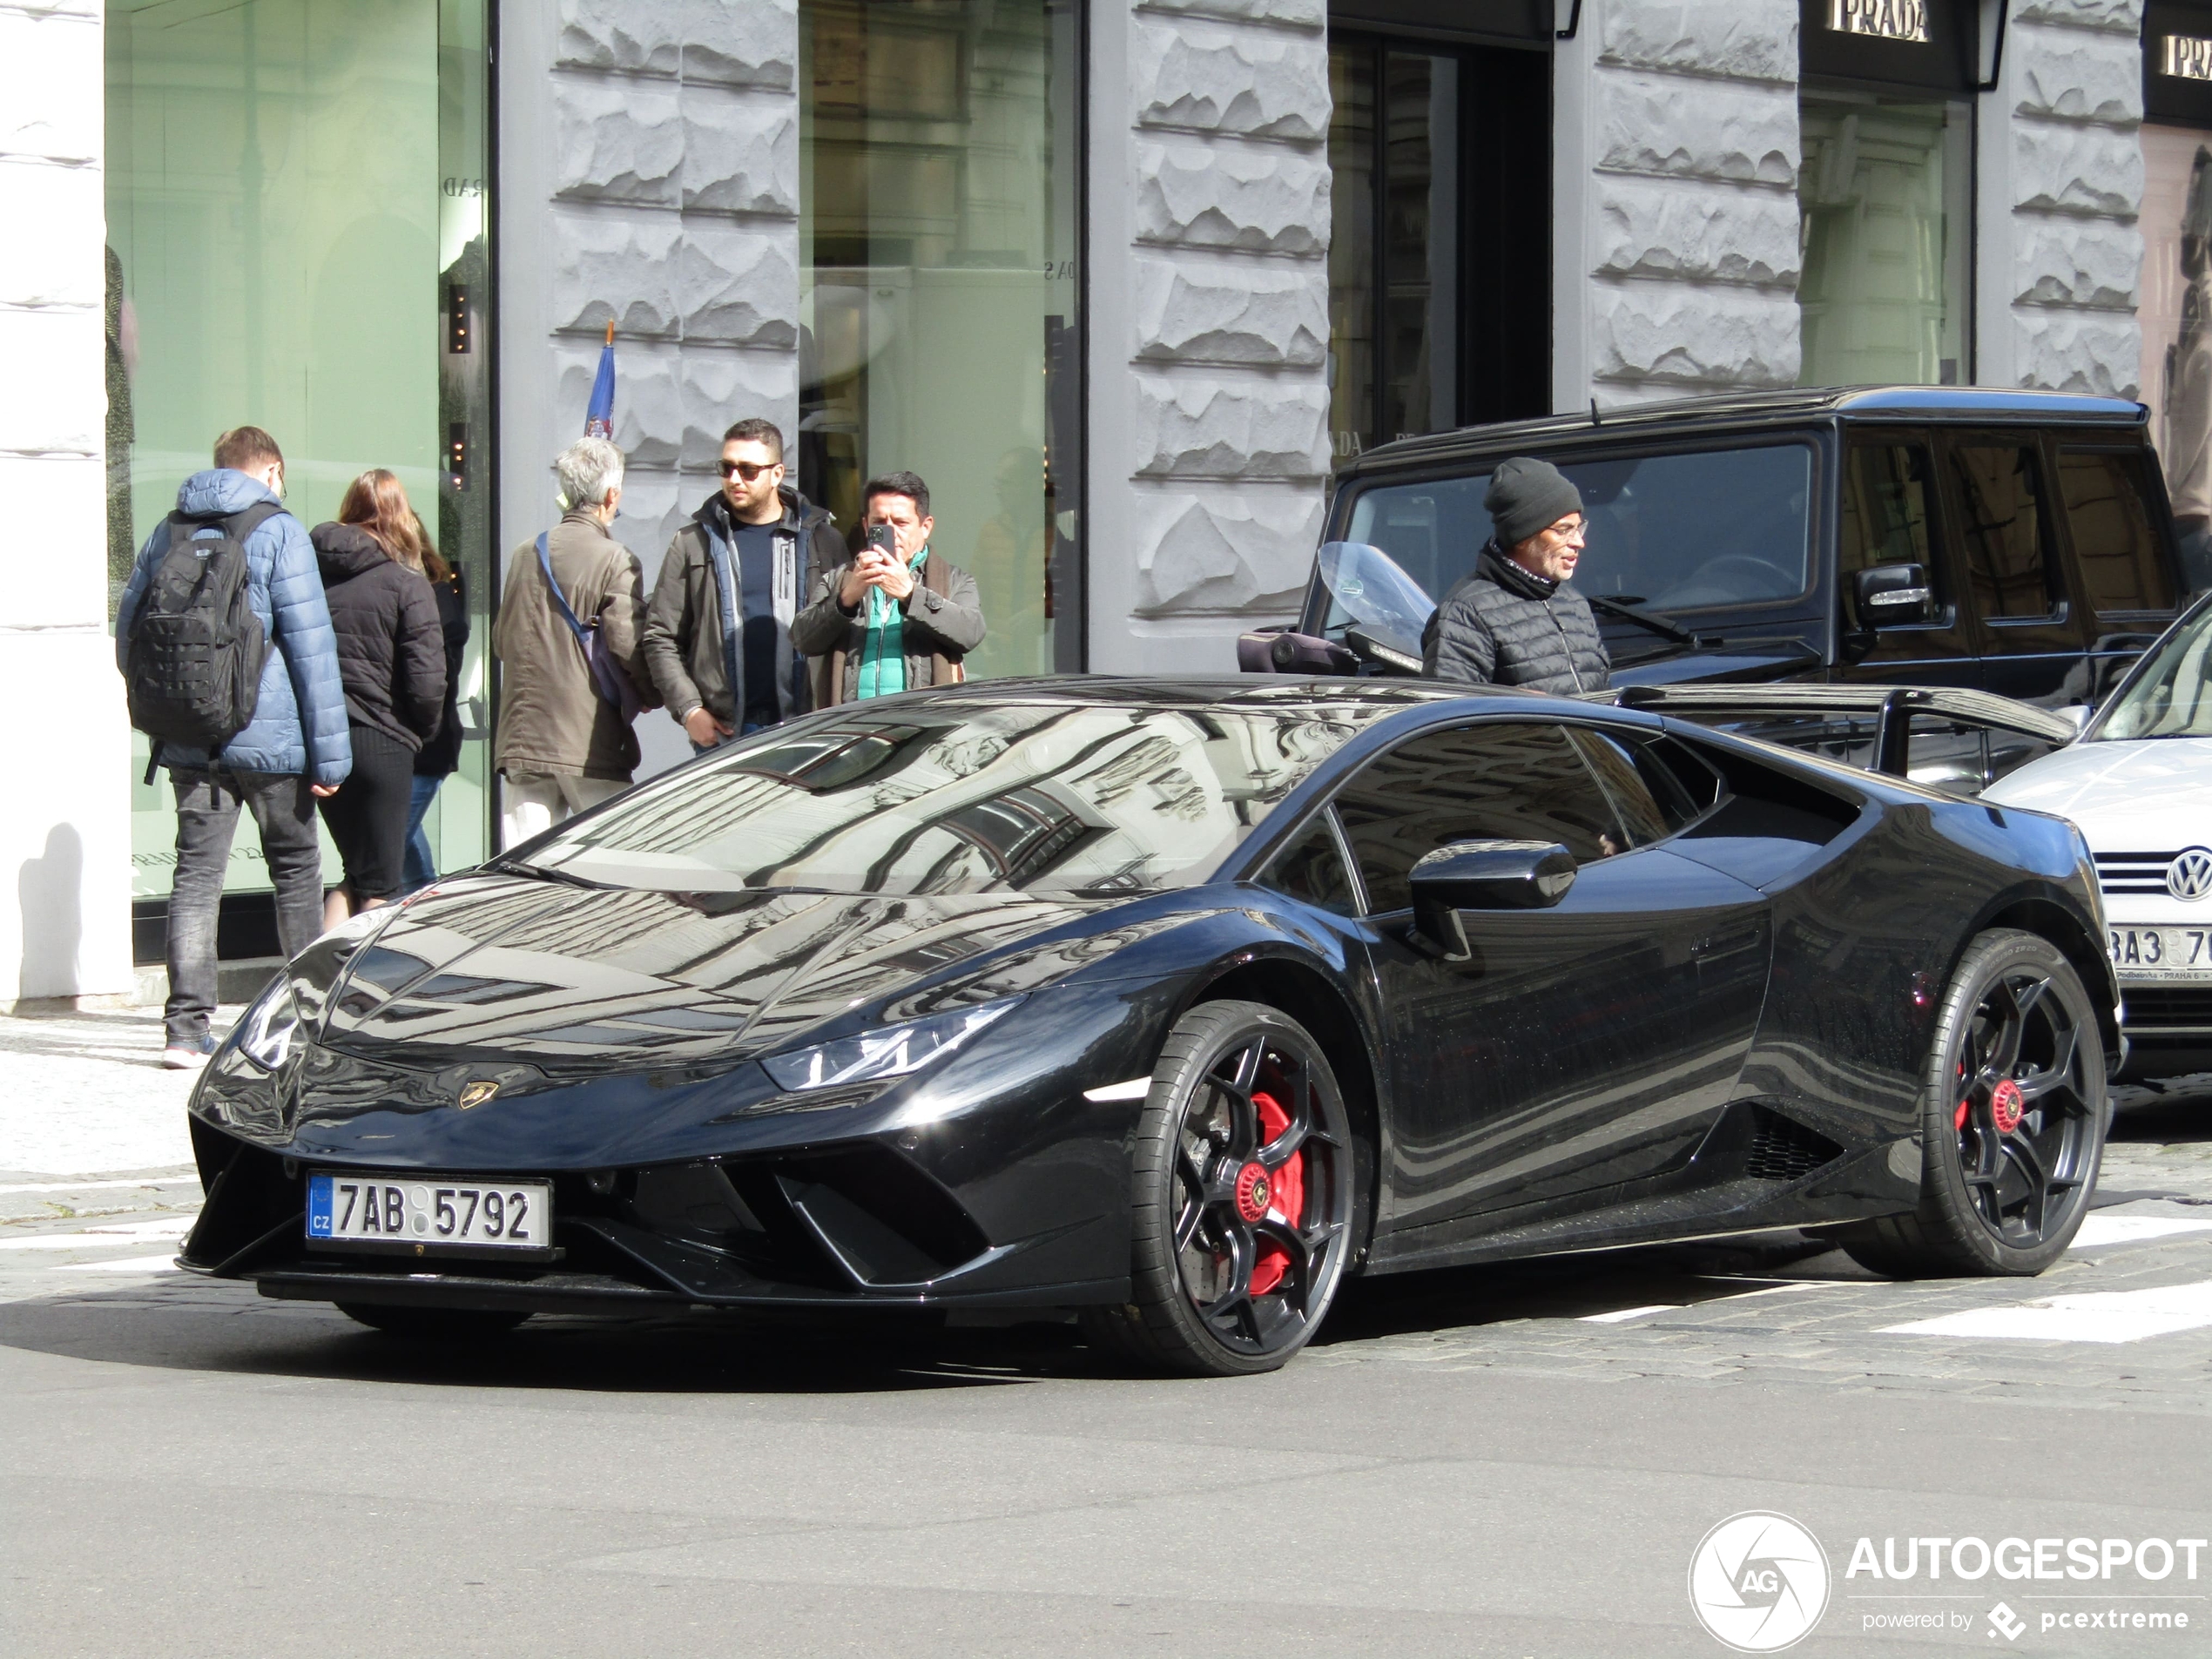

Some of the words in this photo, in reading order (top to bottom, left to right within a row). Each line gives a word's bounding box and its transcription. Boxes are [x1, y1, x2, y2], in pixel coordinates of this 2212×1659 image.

[1828, 0, 1932, 43] PRADA
[2163, 36, 2212, 80] PR
[132, 852, 178, 866] RAD
[2187, 931, 2212, 964] 7
[314, 1216, 329, 1229] CZ
[341, 1184, 406, 1232] 7AB
[435, 1189, 530, 1238] 5792
